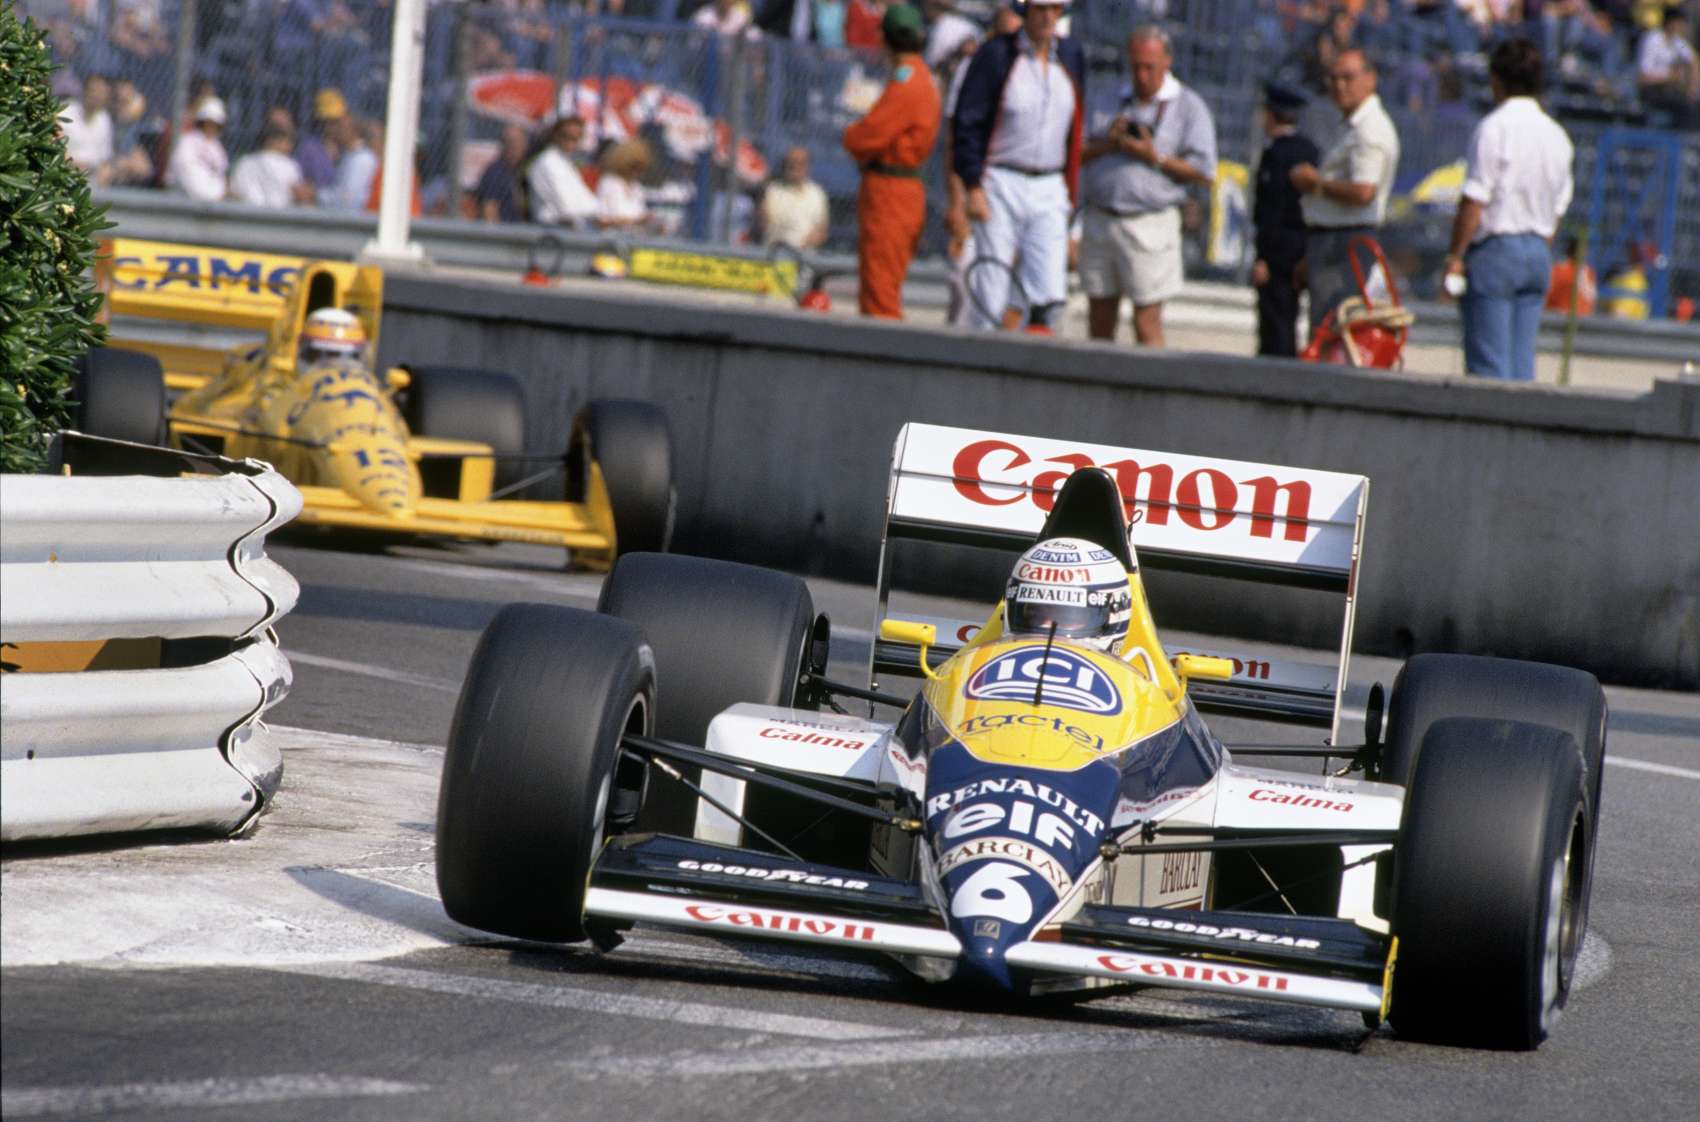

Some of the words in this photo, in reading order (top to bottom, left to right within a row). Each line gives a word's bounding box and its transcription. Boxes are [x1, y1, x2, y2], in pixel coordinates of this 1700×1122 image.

[112, 256, 300, 297] CAME
[952, 440, 1313, 543] Canon
[1032, 549, 1079, 561] DENIM
[1018, 563, 1091, 582] Canon
[1019, 586, 1084, 603] RENAULT
[1088, 592, 1107, 605] elf
[997, 657, 1095, 690] ICI
[759, 727, 865, 750] Calma
[927, 778, 1105, 837] RENAULT
[1248, 789, 1354, 812] Calma
[944, 800, 1075, 850] elf
[677, 860, 869, 890] GOODYEAR
[937, 840, 1068, 889] BARCLAY
[951, 861, 1033, 924] 6
[685, 905, 875, 941] Canon
[1128, 916, 1320, 949] GOODYEAR
[1096, 954, 1288, 991] Canon
